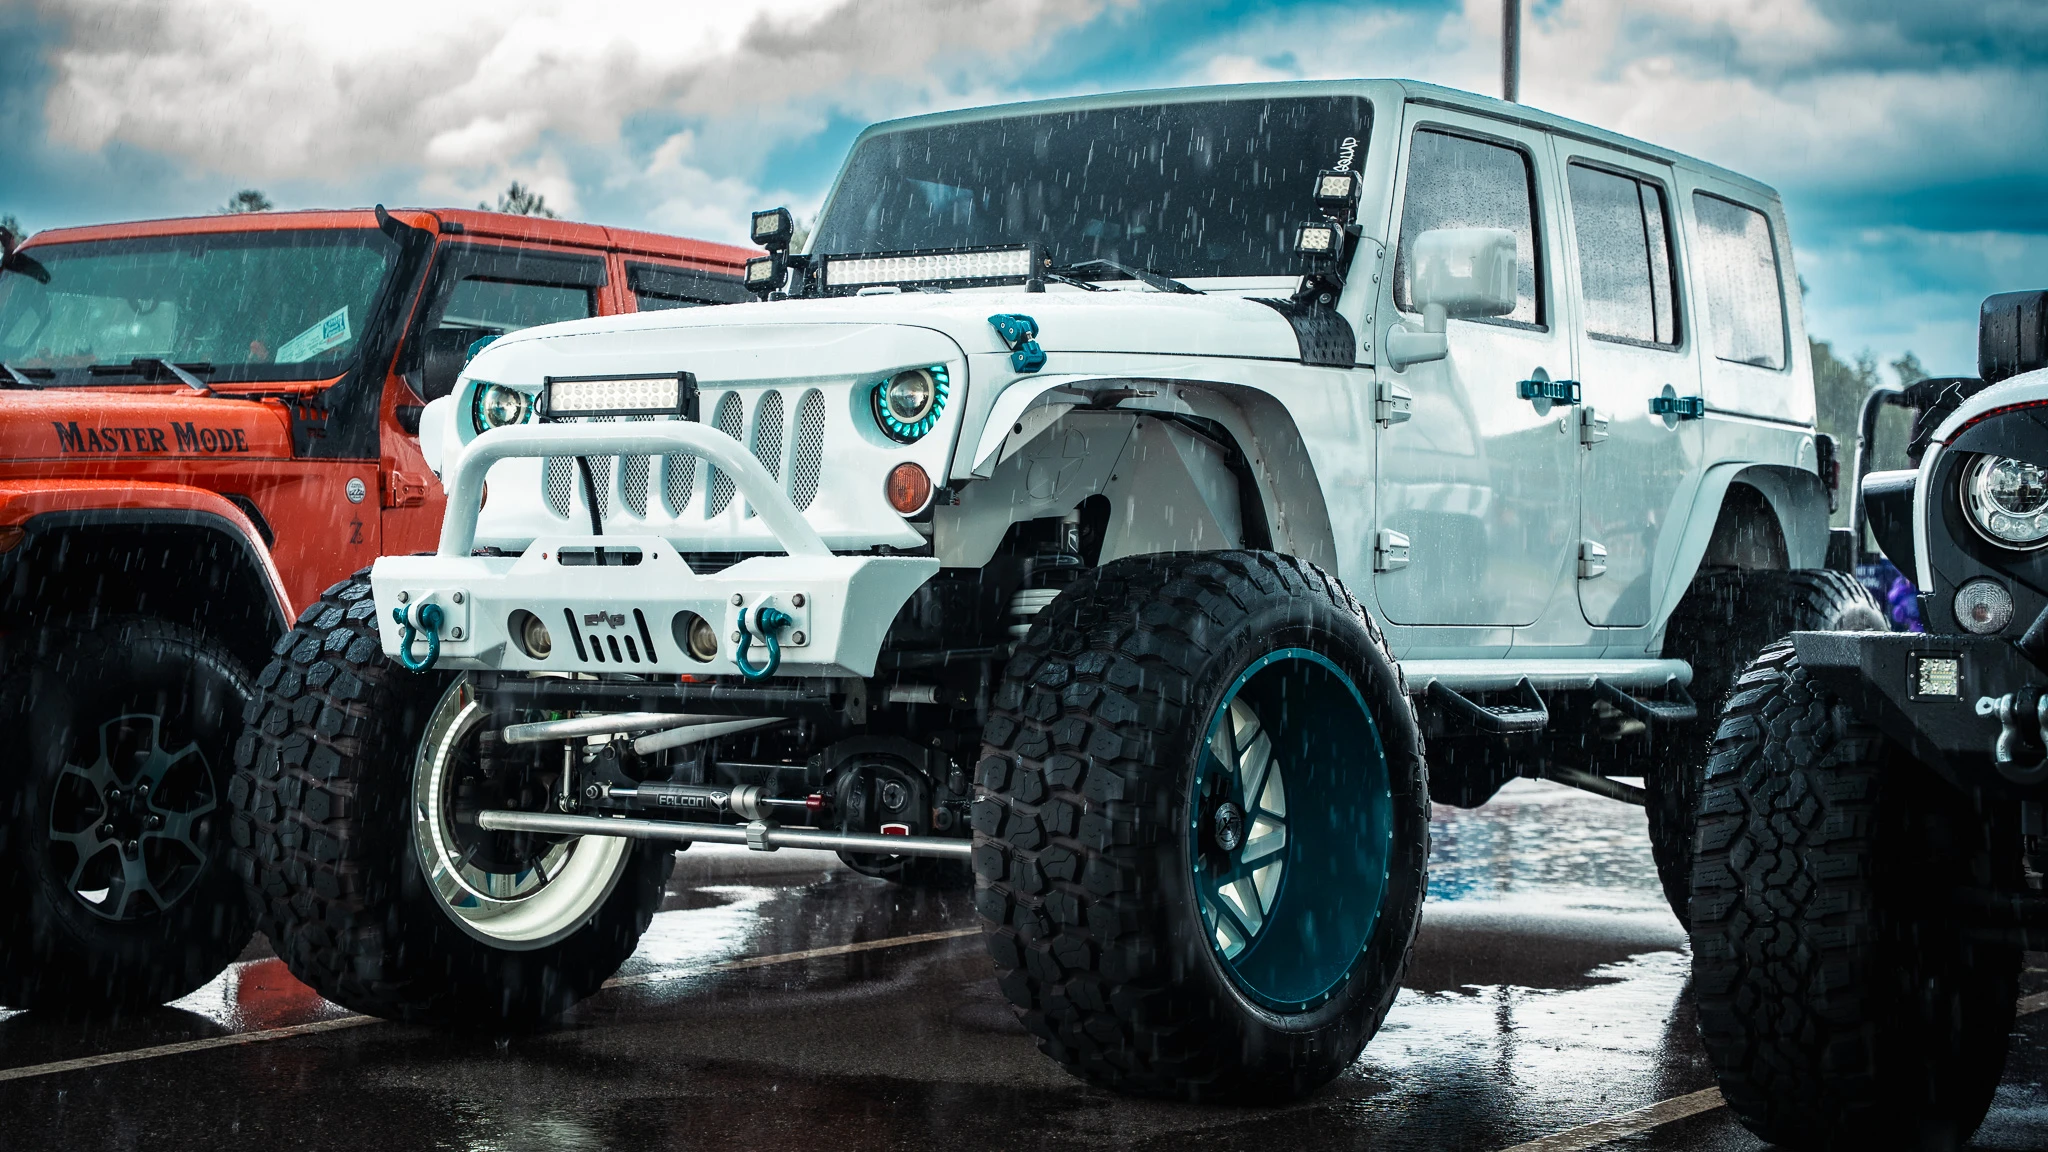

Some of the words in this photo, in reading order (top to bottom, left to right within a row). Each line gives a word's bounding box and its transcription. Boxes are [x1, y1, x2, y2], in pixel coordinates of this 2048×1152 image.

[1333, 137, 1358, 171] SQUAD
[51, 421, 169, 453] MASTER
[170, 421, 249, 453] MODE
[658, 794, 705, 807] FALCON
